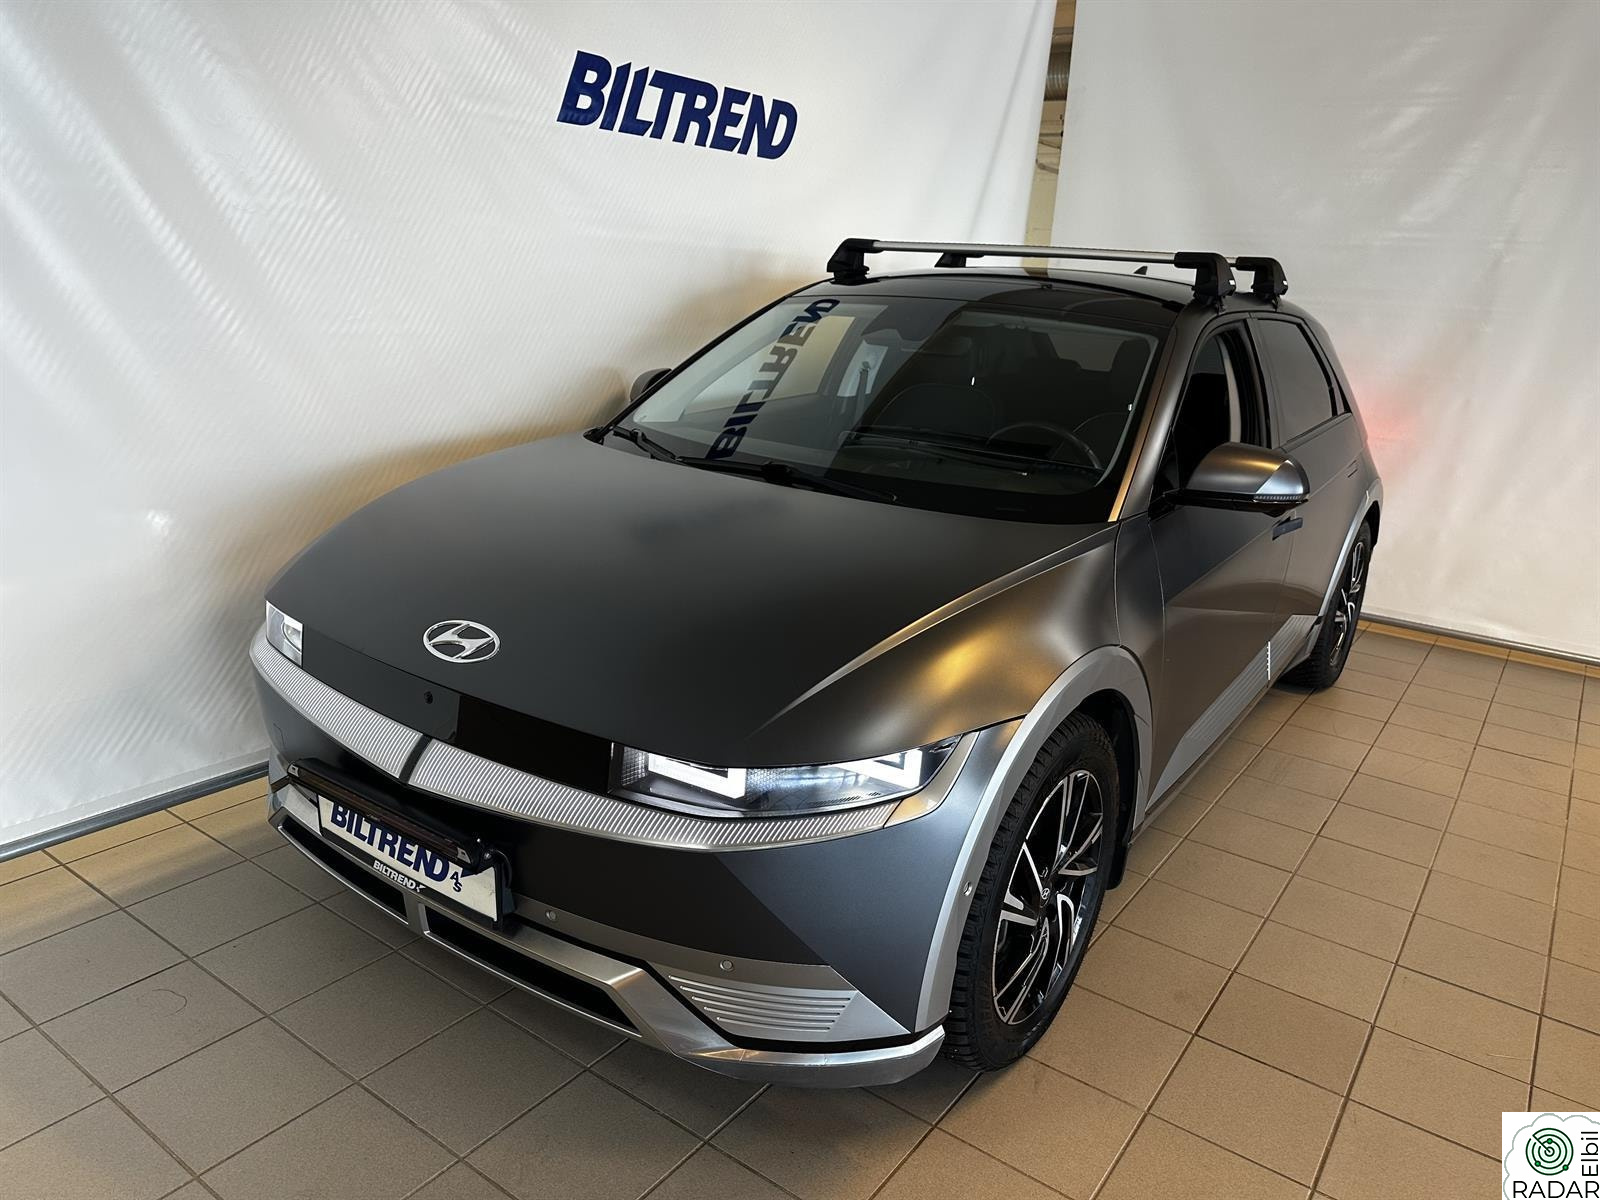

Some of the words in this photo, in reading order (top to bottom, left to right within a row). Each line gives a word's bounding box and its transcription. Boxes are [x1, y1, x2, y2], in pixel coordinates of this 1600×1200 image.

[556, 50, 798, 160] BILTREND
[330, 802, 450, 882] BILTREND
[373, 860, 416, 890] BILTREND
